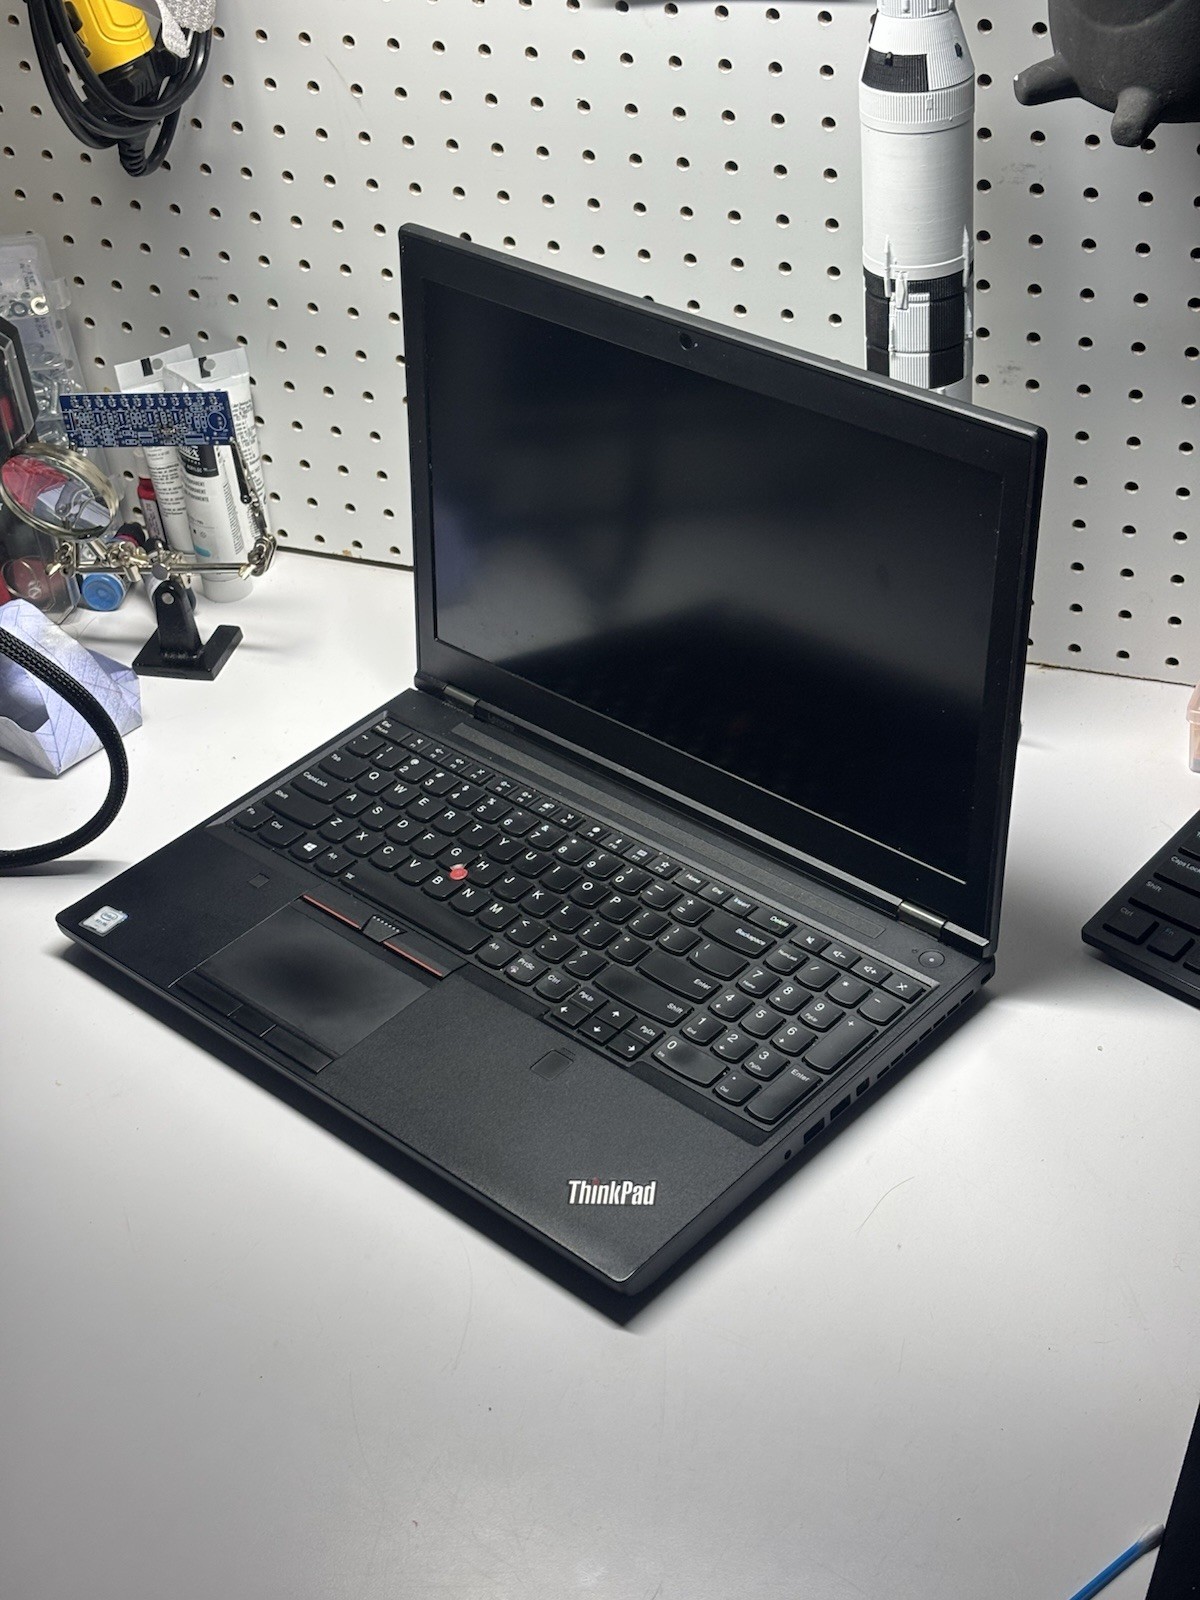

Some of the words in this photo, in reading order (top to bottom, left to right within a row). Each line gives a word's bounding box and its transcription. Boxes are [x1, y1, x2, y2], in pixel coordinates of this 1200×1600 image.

[399, 765, 409, 773] 2
[368, 771, 380, 780] Q
[424, 778, 435, 786] 3
[393, 784, 408, 794] W
[346, 793, 357, 802] A
[418, 797, 430, 806] E
[372, 806, 384, 815] S
[444, 810, 456, 820] R
[330, 817, 343, 827] Z
[397, 820, 409, 828] D
[503, 818, 513, 826] 6
[471, 823, 483, 833] T
[355, 831, 369, 841] X
[422, 832, 435, 841] F
[499, 837, 511, 846] Y
[382, 846, 395, 854] C
[450, 847, 463, 857] G
[558, 846, 568, 854] 8
[525, 851, 538, 860] U
[410, 859, 421, 868] V
[476, 861, 490, 871] H
[586, 860, 597, 868] 9
[1171, 855, 1186, 868] Caps
[431, 875, 444, 885] B
[504, 876, 516, 884] J
[615, 875, 625, 883] 0
[582, 881, 594, 891] O
[1146, 881, 1162, 892] Shift
[461, 888, 475, 898] N
[532, 890, 545, 900] K
[609, 896, 622, 904] P
[489, 903, 504, 915] M
[560, 905, 569, 915] L
[1120, 907, 1134, 917] Ctrl
[752, 970, 764, 978] 7
[693, 978, 711, 990] Enter
[782, 986, 794, 995] 8
[725, 994, 735, 1002] 4
[666, 1002, 684, 1014] Shift
[814, 1002, 825, 1011] 9
[755, 1009, 767, 1019] 5
[698, 1017, 707, 1025] 1
[786, 1026, 798, 1036] 6
[726, 1033, 739, 1043] 2
[666, 1040, 678, 1050] 0
[758, 1050, 770, 1060] 3
[790, 1068, 810, 1082] Enter
[568, 1177, 657, 1206] ThinkPad
